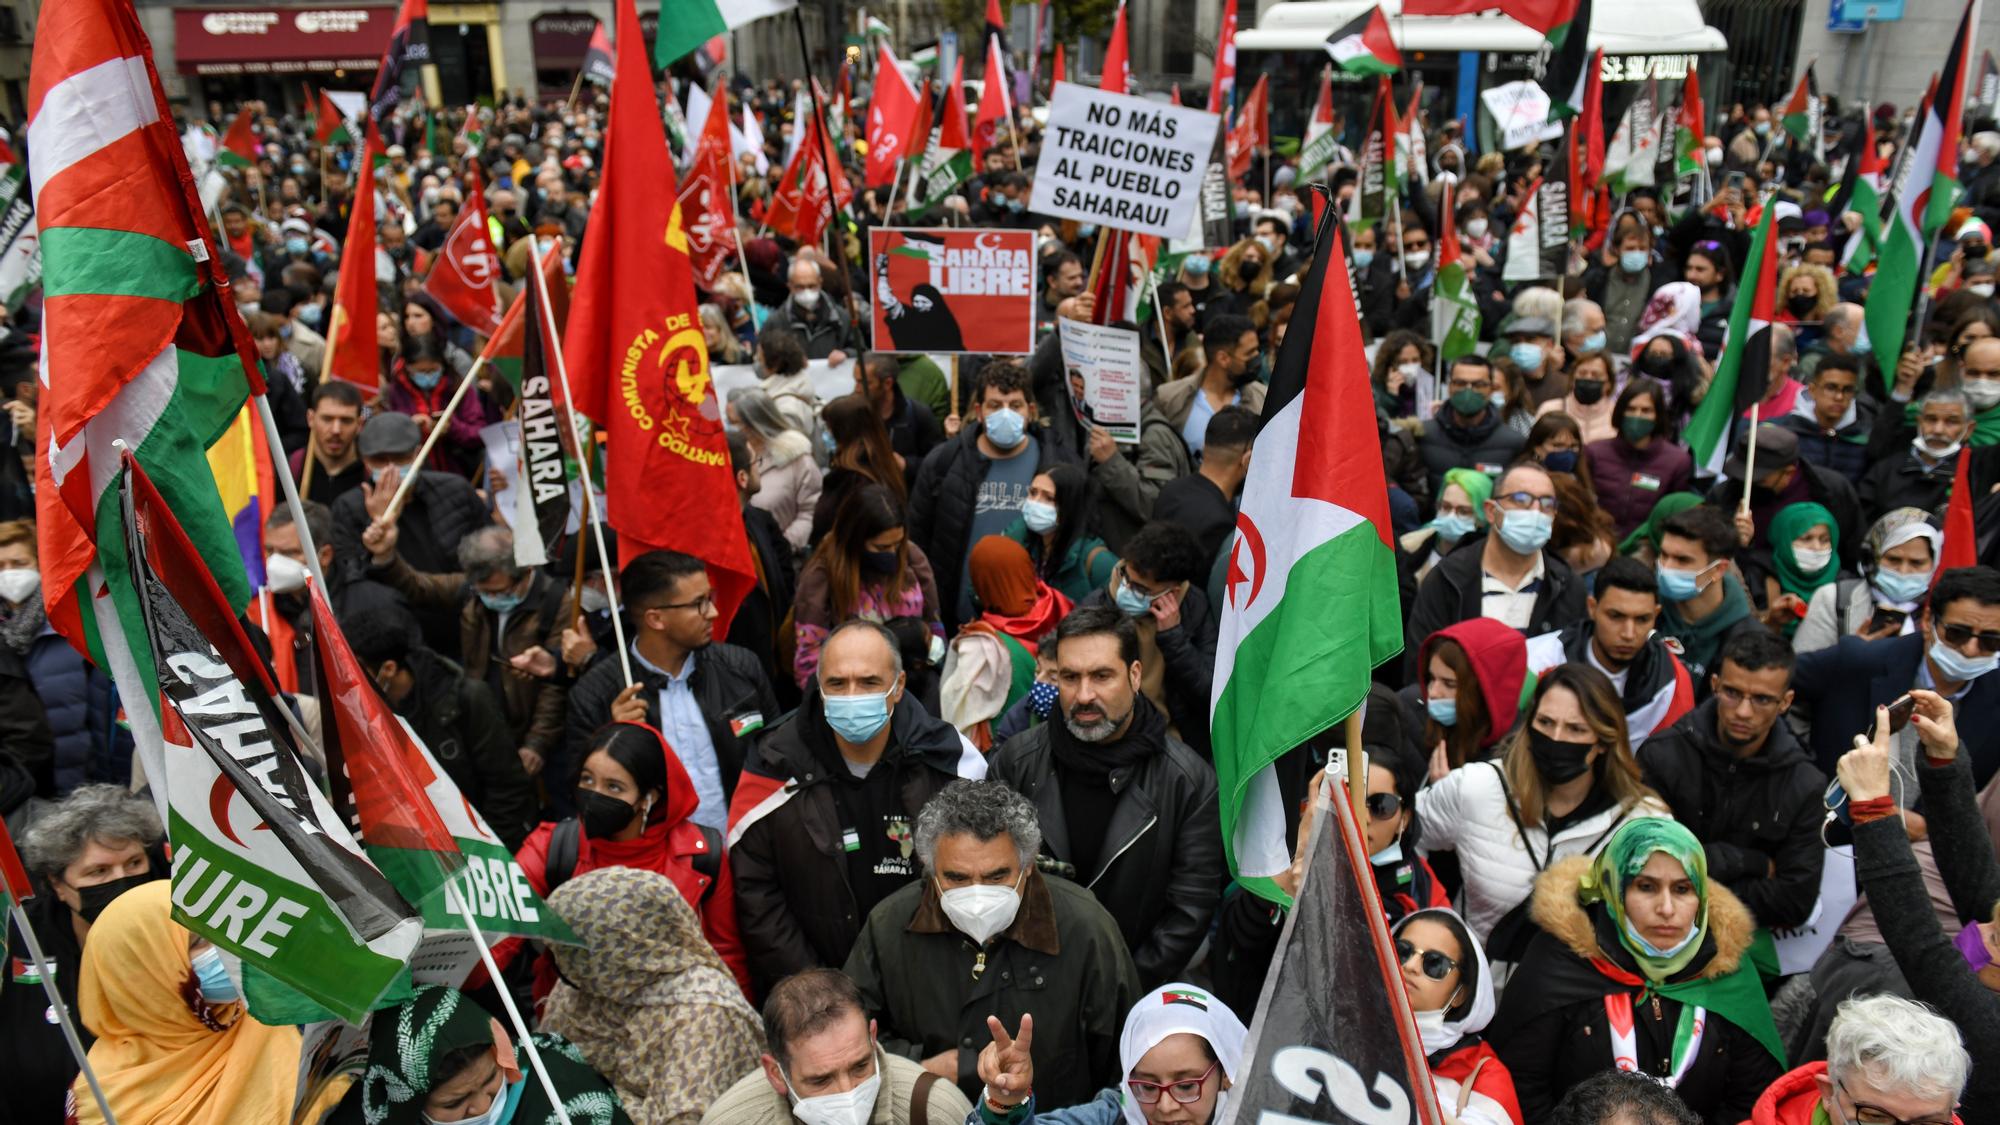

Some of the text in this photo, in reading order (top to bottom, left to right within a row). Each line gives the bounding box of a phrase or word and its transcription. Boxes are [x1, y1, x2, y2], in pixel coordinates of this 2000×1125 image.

[1087, 102, 1178, 139] NO MÁS
[1056, 126, 1195, 173] TRAICIONES
[1053, 157, 1180, 199] AL PUEBLO
[1202, 162, 1227, 221] SAHARA
[1053, 187, 1169, 227] SAHARAUI
[1540, 181, 1568, 248] SAHARA
[928, 248, 1030, 268] SAHARA
[929, 266, 1030, 296] LIBRE
[620, 313, 726, 466] PARTIDO COMUNISTA DE
[521, 375, 566, 505] SAHARA
[873, 863, 907, 875] SÁHARA
